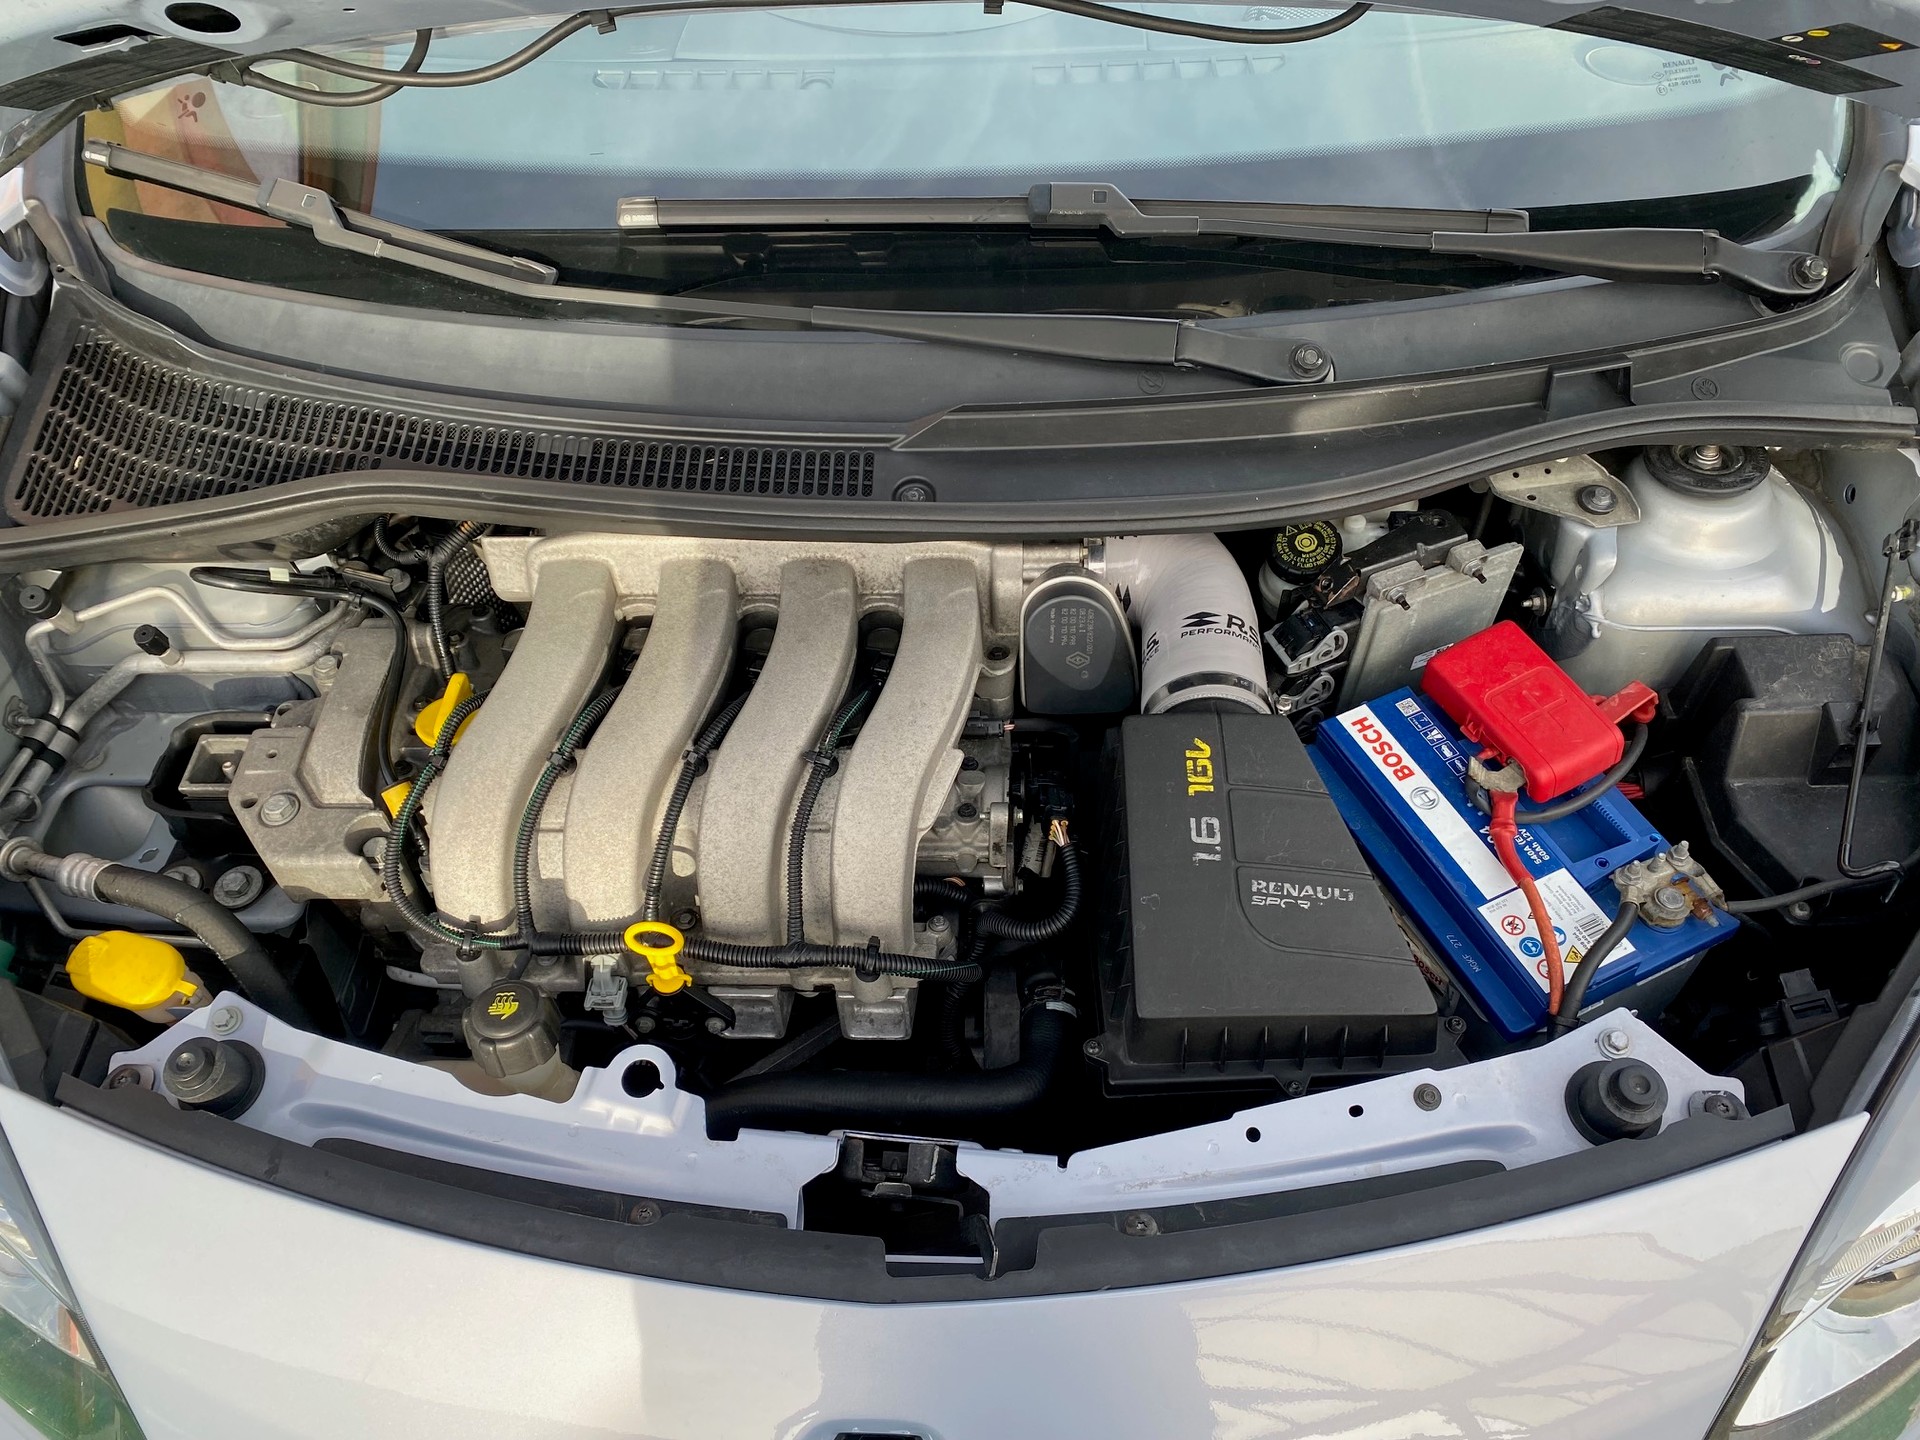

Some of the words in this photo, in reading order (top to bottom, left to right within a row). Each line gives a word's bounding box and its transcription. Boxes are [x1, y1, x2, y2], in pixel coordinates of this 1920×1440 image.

[1662, 59, 1695, 69] RENAULT
[1351, 716, 1415, 782] BOSCH
[1185, 737, 1214, 796] 16V
[1189, 816, 1222, 866] 1.6
[1518, 828, 1534, 842] 12V
[1523, 844, 1543, 865] 540A
[1532, 841, 1550, 861] 60Ah
[1251, 879, 1354, 902] RENAULT
